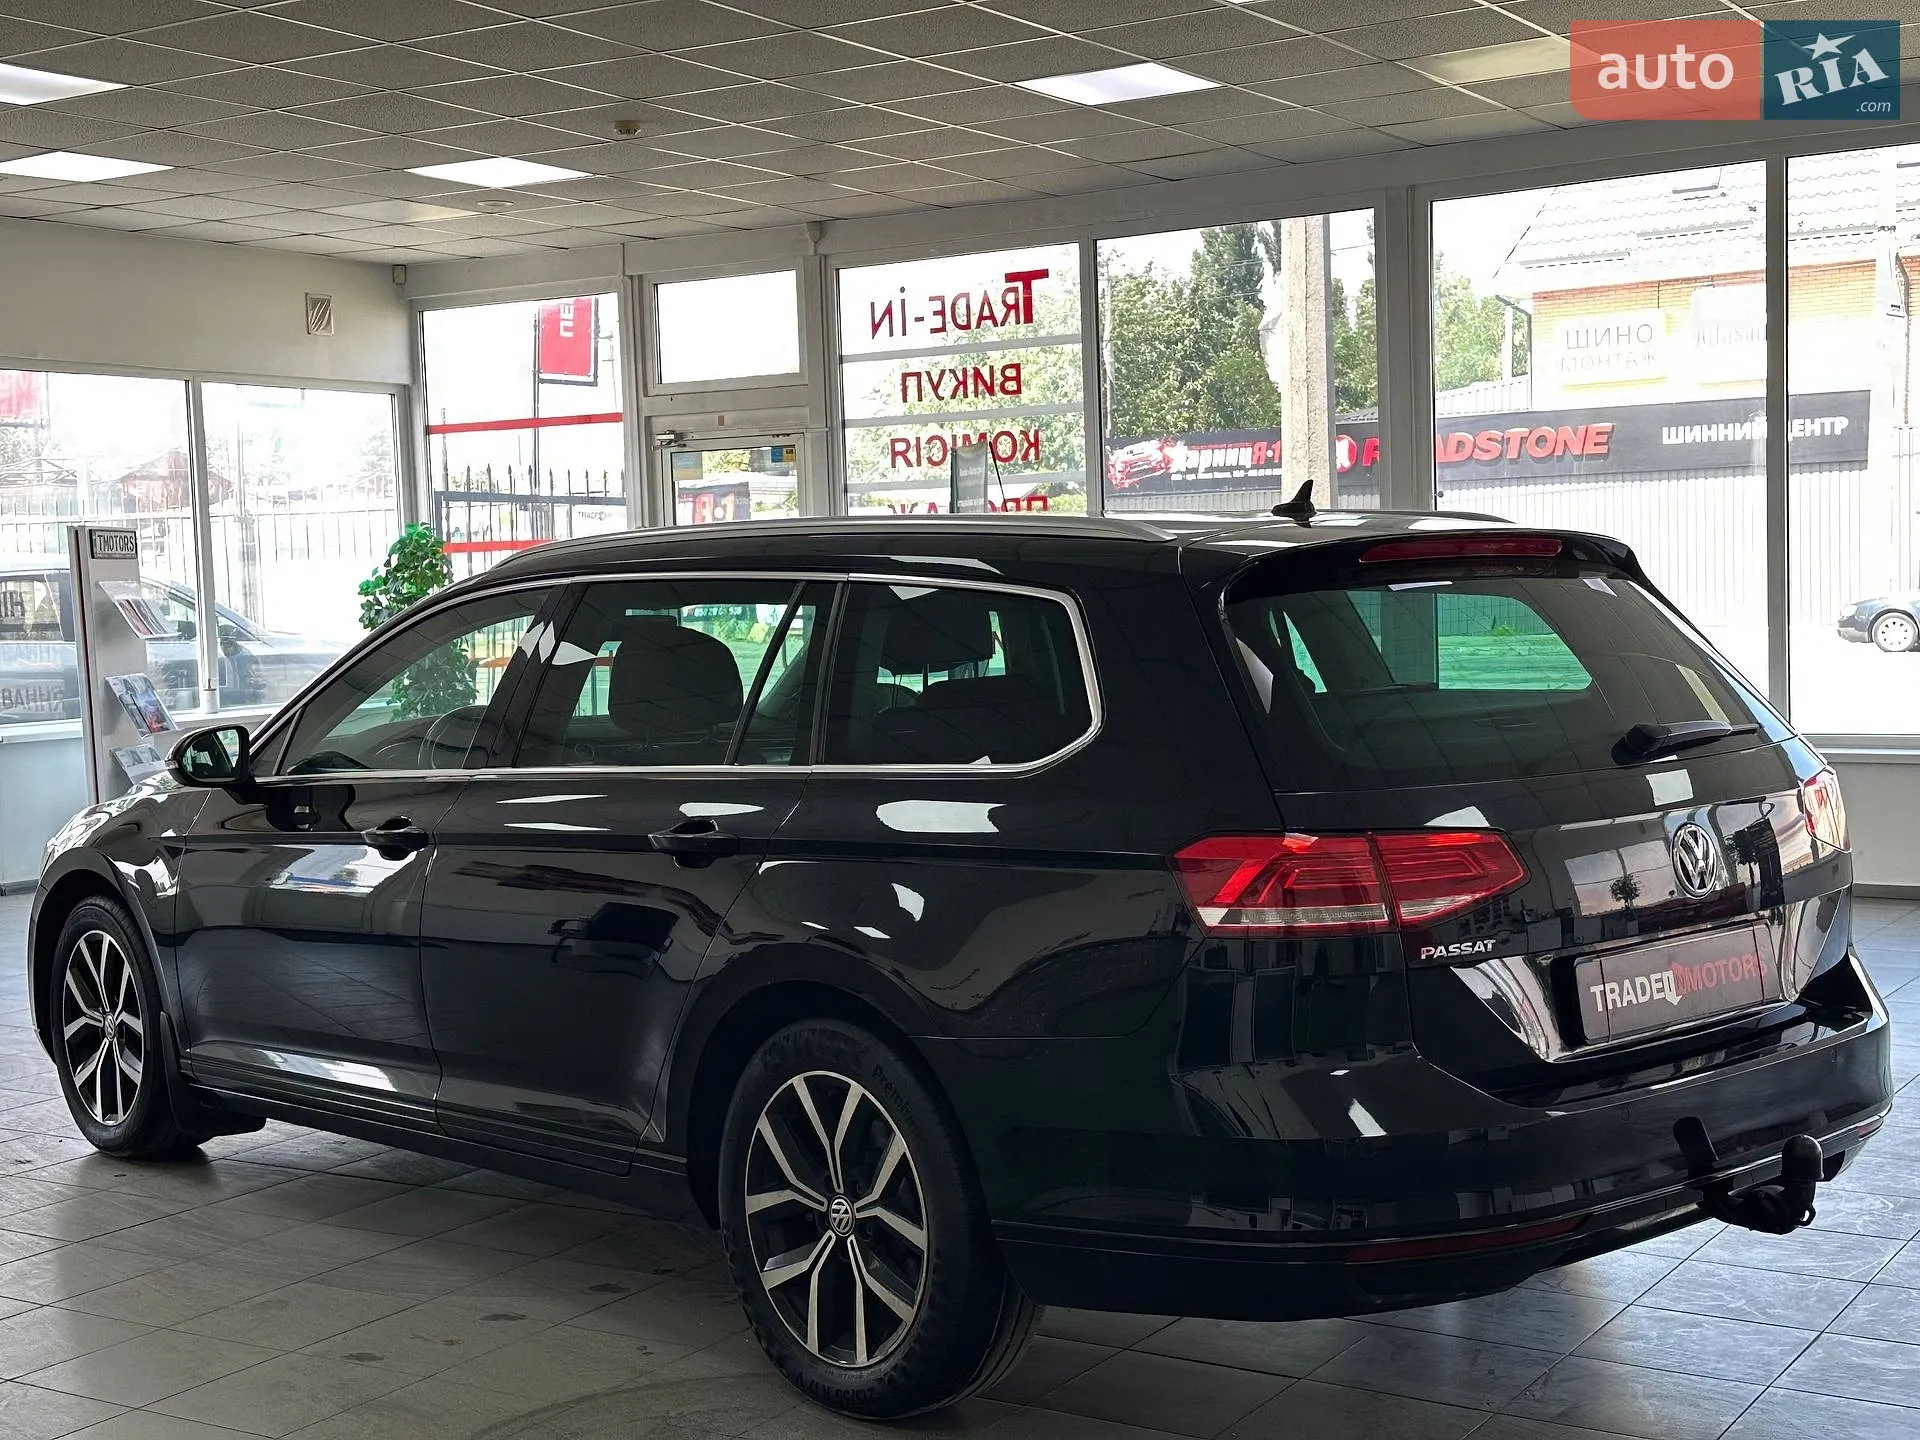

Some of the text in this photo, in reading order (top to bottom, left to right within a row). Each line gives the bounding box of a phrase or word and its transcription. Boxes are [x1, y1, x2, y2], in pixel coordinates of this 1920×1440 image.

[1566, 323, 1653, 350] ШИНО
[1662, 413, 1768, 445] ШИННИЙ
[1421, 939, 1496, 960] PASSAT
